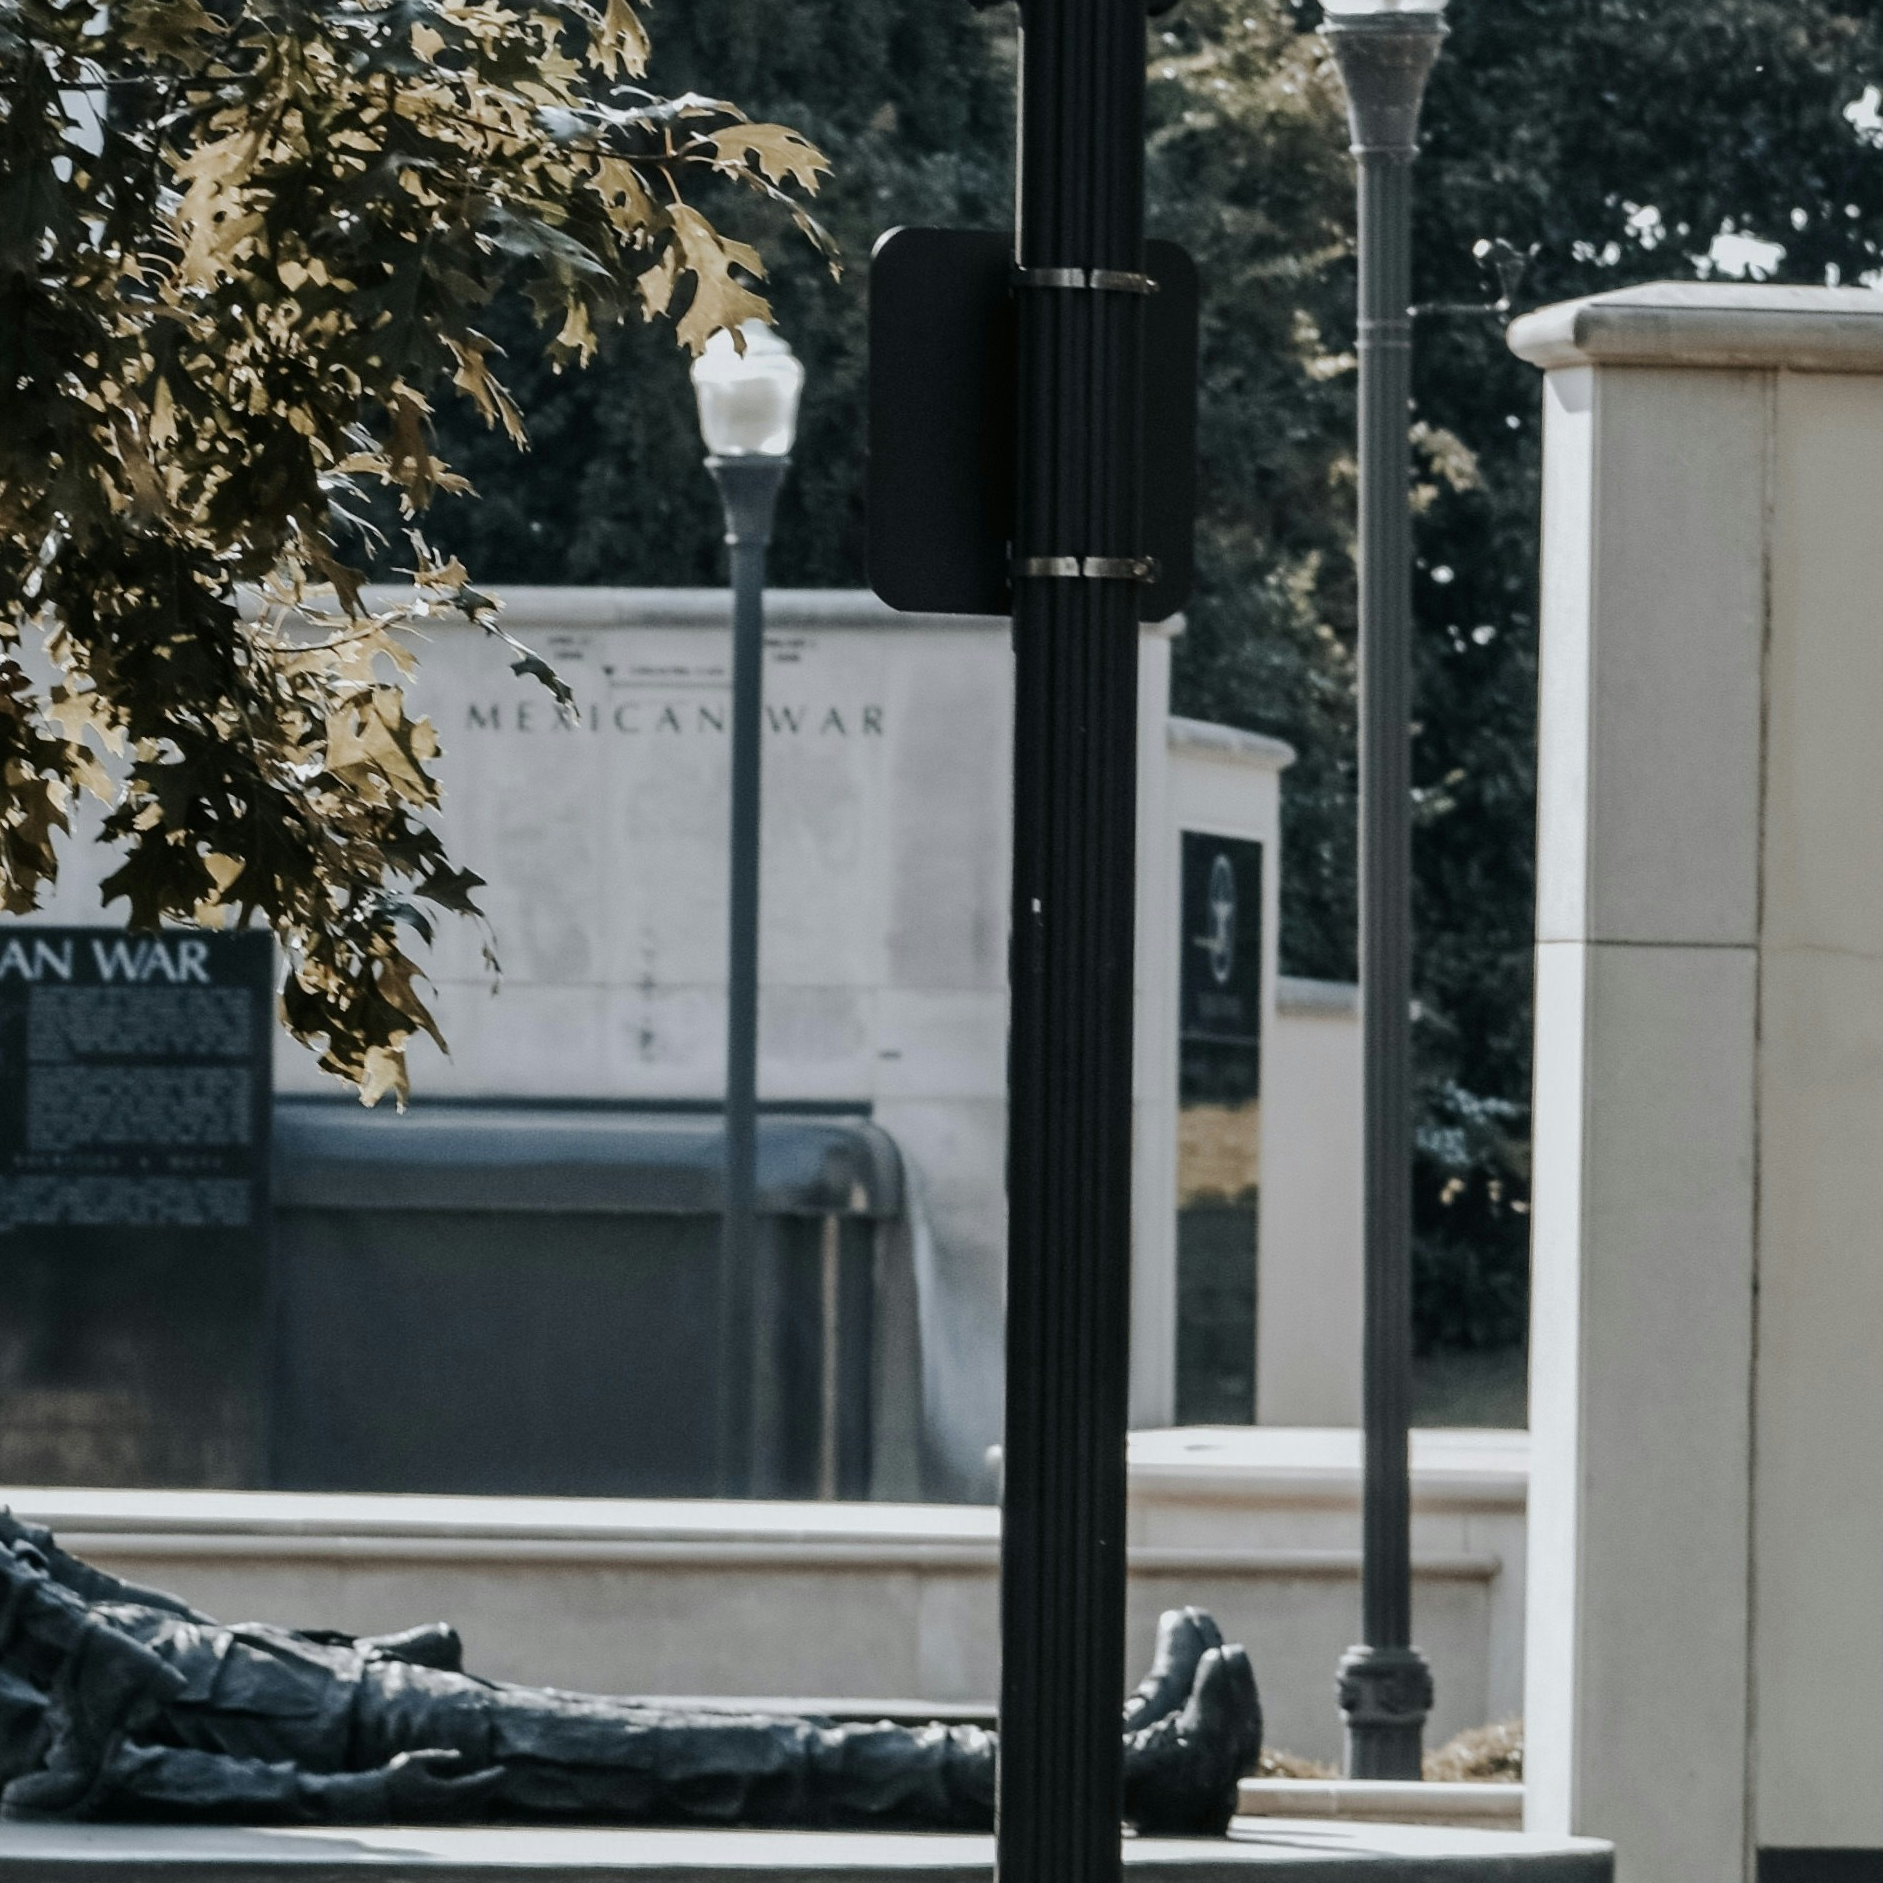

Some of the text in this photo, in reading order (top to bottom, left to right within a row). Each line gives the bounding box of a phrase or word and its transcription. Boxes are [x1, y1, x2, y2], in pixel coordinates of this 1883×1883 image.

[467, 701, 883, 735] MEXICAN WAR
[91, 939, 211, 983] WAR
